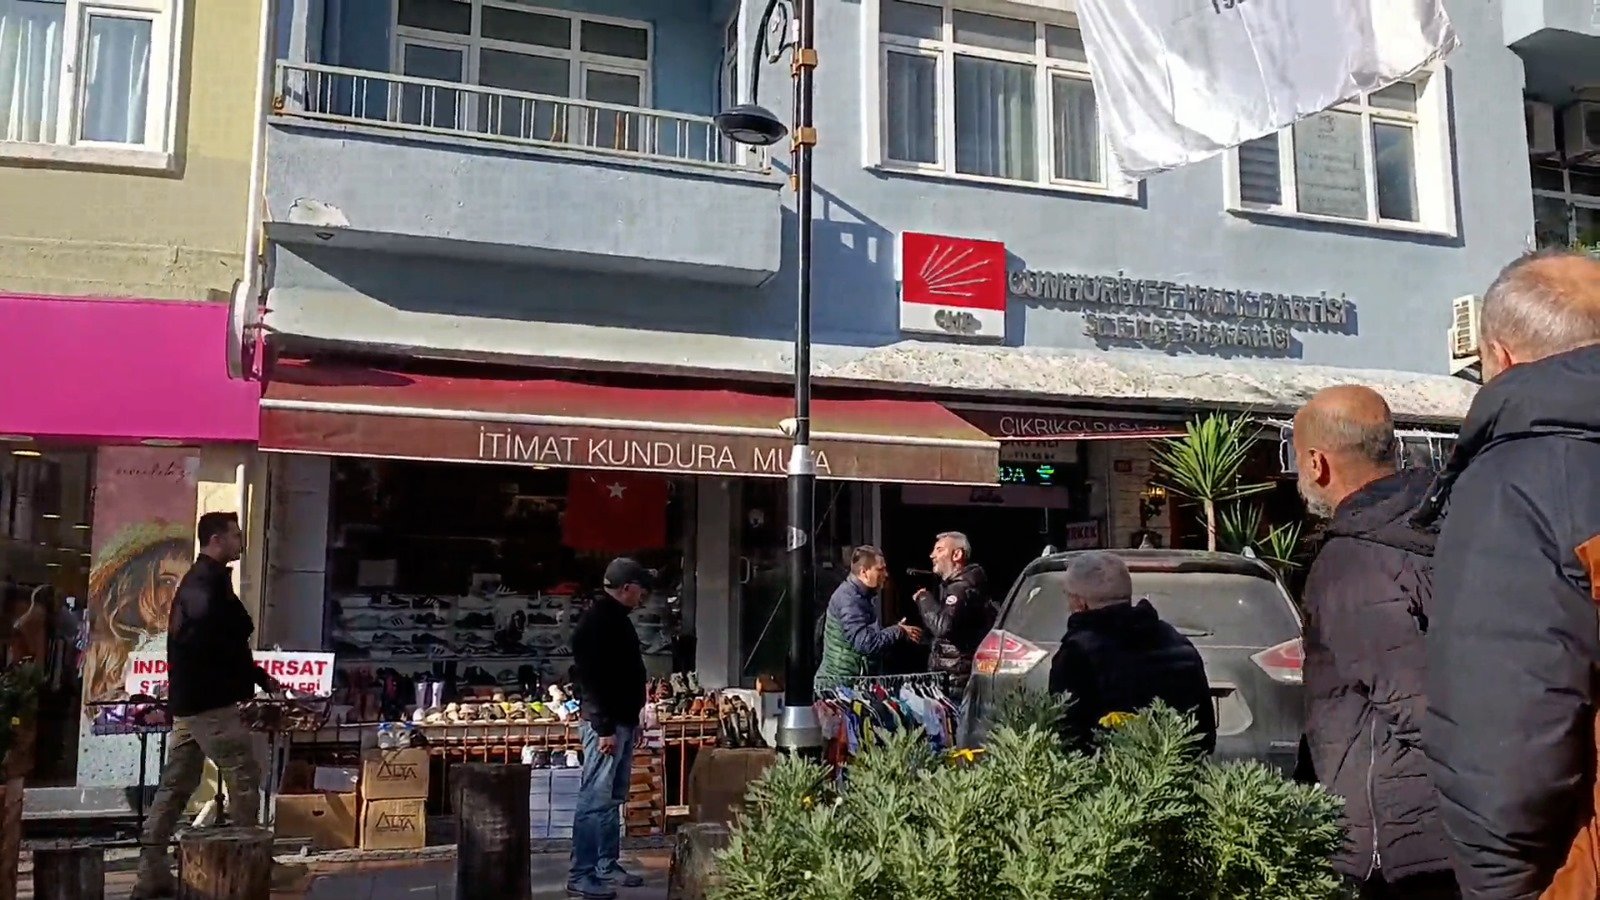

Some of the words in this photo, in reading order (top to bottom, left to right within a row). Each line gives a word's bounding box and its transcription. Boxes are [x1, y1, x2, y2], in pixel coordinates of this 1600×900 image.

[478, 425, 579, 462] İTİMAT
[588, 438, 736, 470] KUNDURA
[753, 447, 832, 475] MUA
[133, 657, 172, 674] İND
